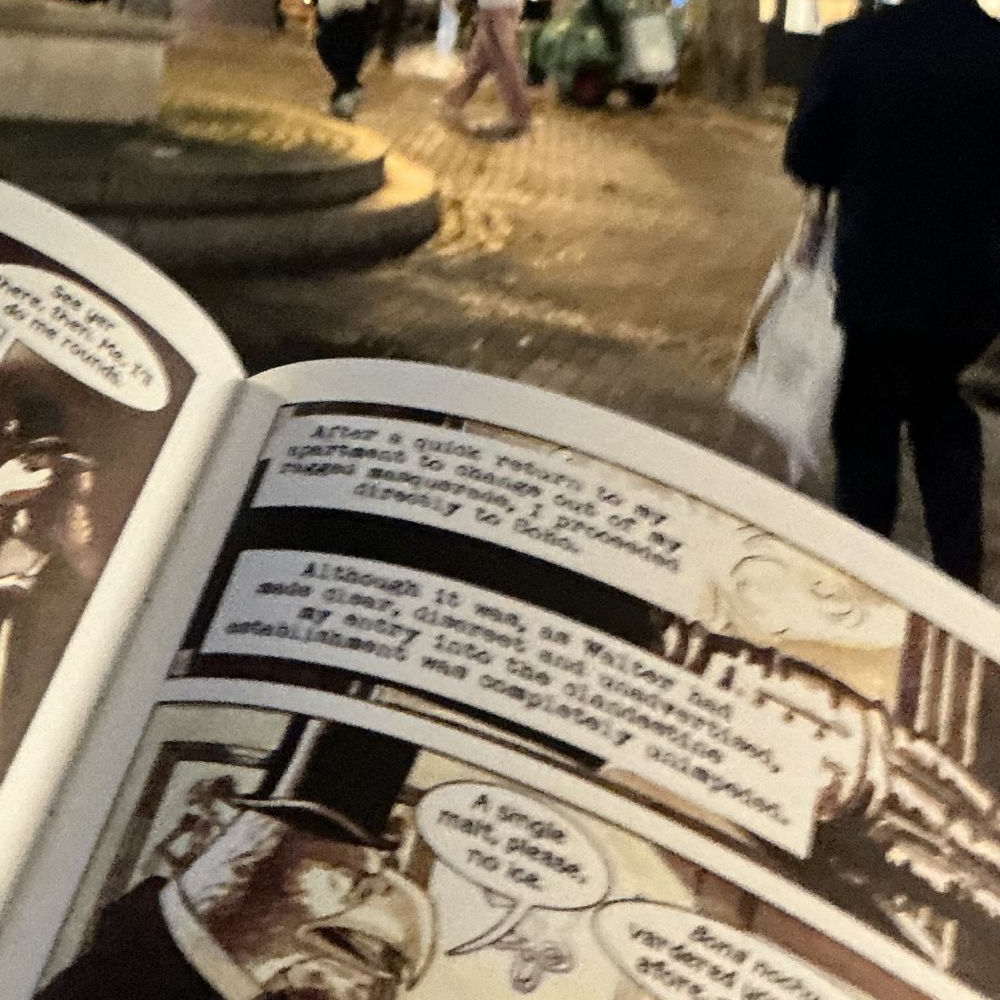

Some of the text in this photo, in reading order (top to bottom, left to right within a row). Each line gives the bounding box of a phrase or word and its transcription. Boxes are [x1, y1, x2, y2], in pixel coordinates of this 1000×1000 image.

[53, 284, 83, 311] See
[288, 443, 684, 554] apartment to change out of my
[309, 423, 378, 443] After
[413, 437, 482, 461] quick
[497, 454, 583, 492] return
[597, 486, 624, 507] to
[634, 505, 669, 527] my
[352, 483, 462, 518] directly
[474, 506, 502, 528] to
[529, 501, 543, 520] I
[556, 516, 680, 575] proceeded
[300, 562, 422, 598] Although
[435, 587, 461, 607] it
[225, 619, 409, 662] establishment
[478, 673, 634, 748] completely
[433, 633, 492, 665] into
[505, 656, 551, 687] the
[472, 793, 490, 812] A
